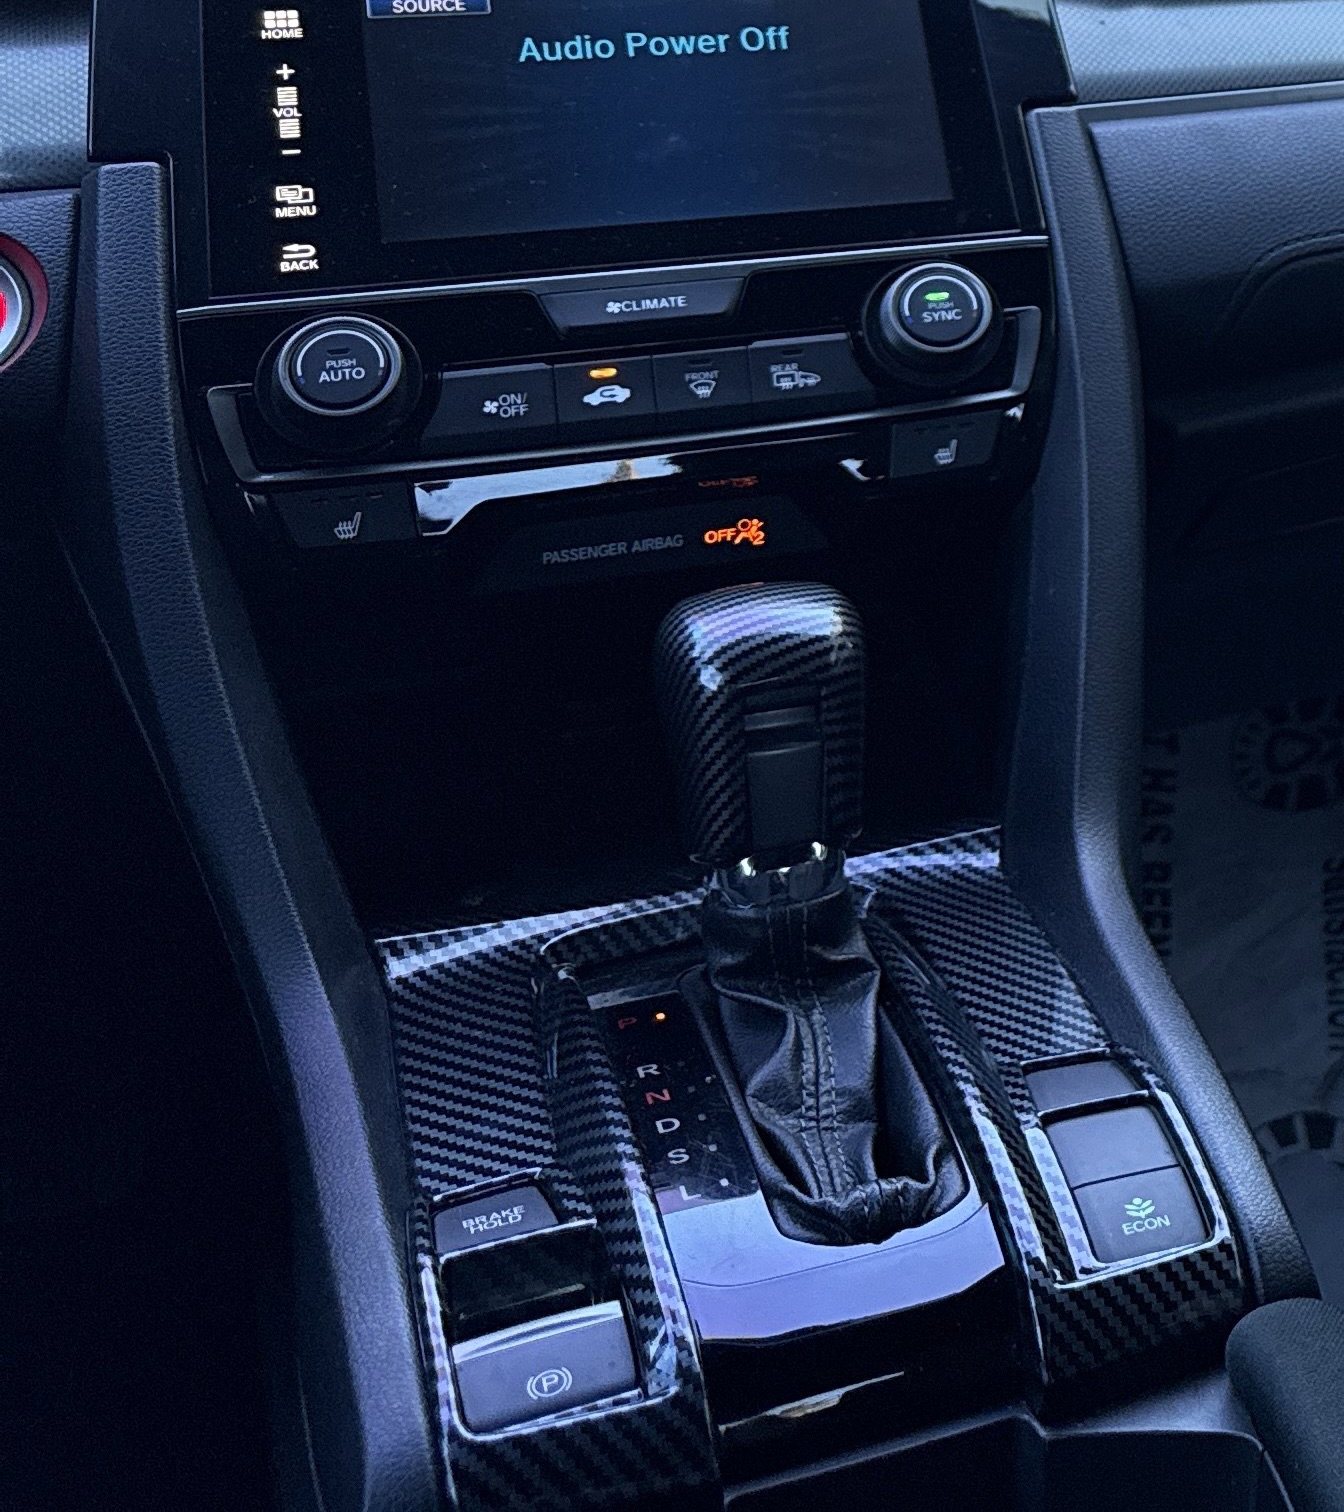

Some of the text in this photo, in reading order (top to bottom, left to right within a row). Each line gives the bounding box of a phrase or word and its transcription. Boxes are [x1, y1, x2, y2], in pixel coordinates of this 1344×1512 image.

[261, 28, 304, 40] HOME
[519, 25, 790, 62] Audio Power Off
[272, 107, 302, 119] VOL
[275, 205, 317, 218] MENU
[279, 259, 320, 273] BACK
[621, 295, 688, 312] CLIMATE
[922, 309, 962, 323] SYNC
[326, 358, 357, 369] PUSH
[319, 367, 366, 384] AUTO
[685, 370, 720, 382] FRONT
[499, 392, 528, 405] ON/
[499, 404, 529, 418] OFF
[542, 541, 628, 565] PASSENGER
[631, 534, 684, 553] AIRBAG
[704, 528, 736, 544] OFF
[637, 1064, 661, 1079] R
[645, 1089, 671, 1105] N
[655, 1118, 680, 1134] D
[667, 1149, 690, 1165] S
[680, 1185, 701, 1201] L
[462, 1205, 526, 1229] BRAKE
[469, 1214, 523, 1235] HOLD
[1121, 1214, 1171, 1235] ECON
